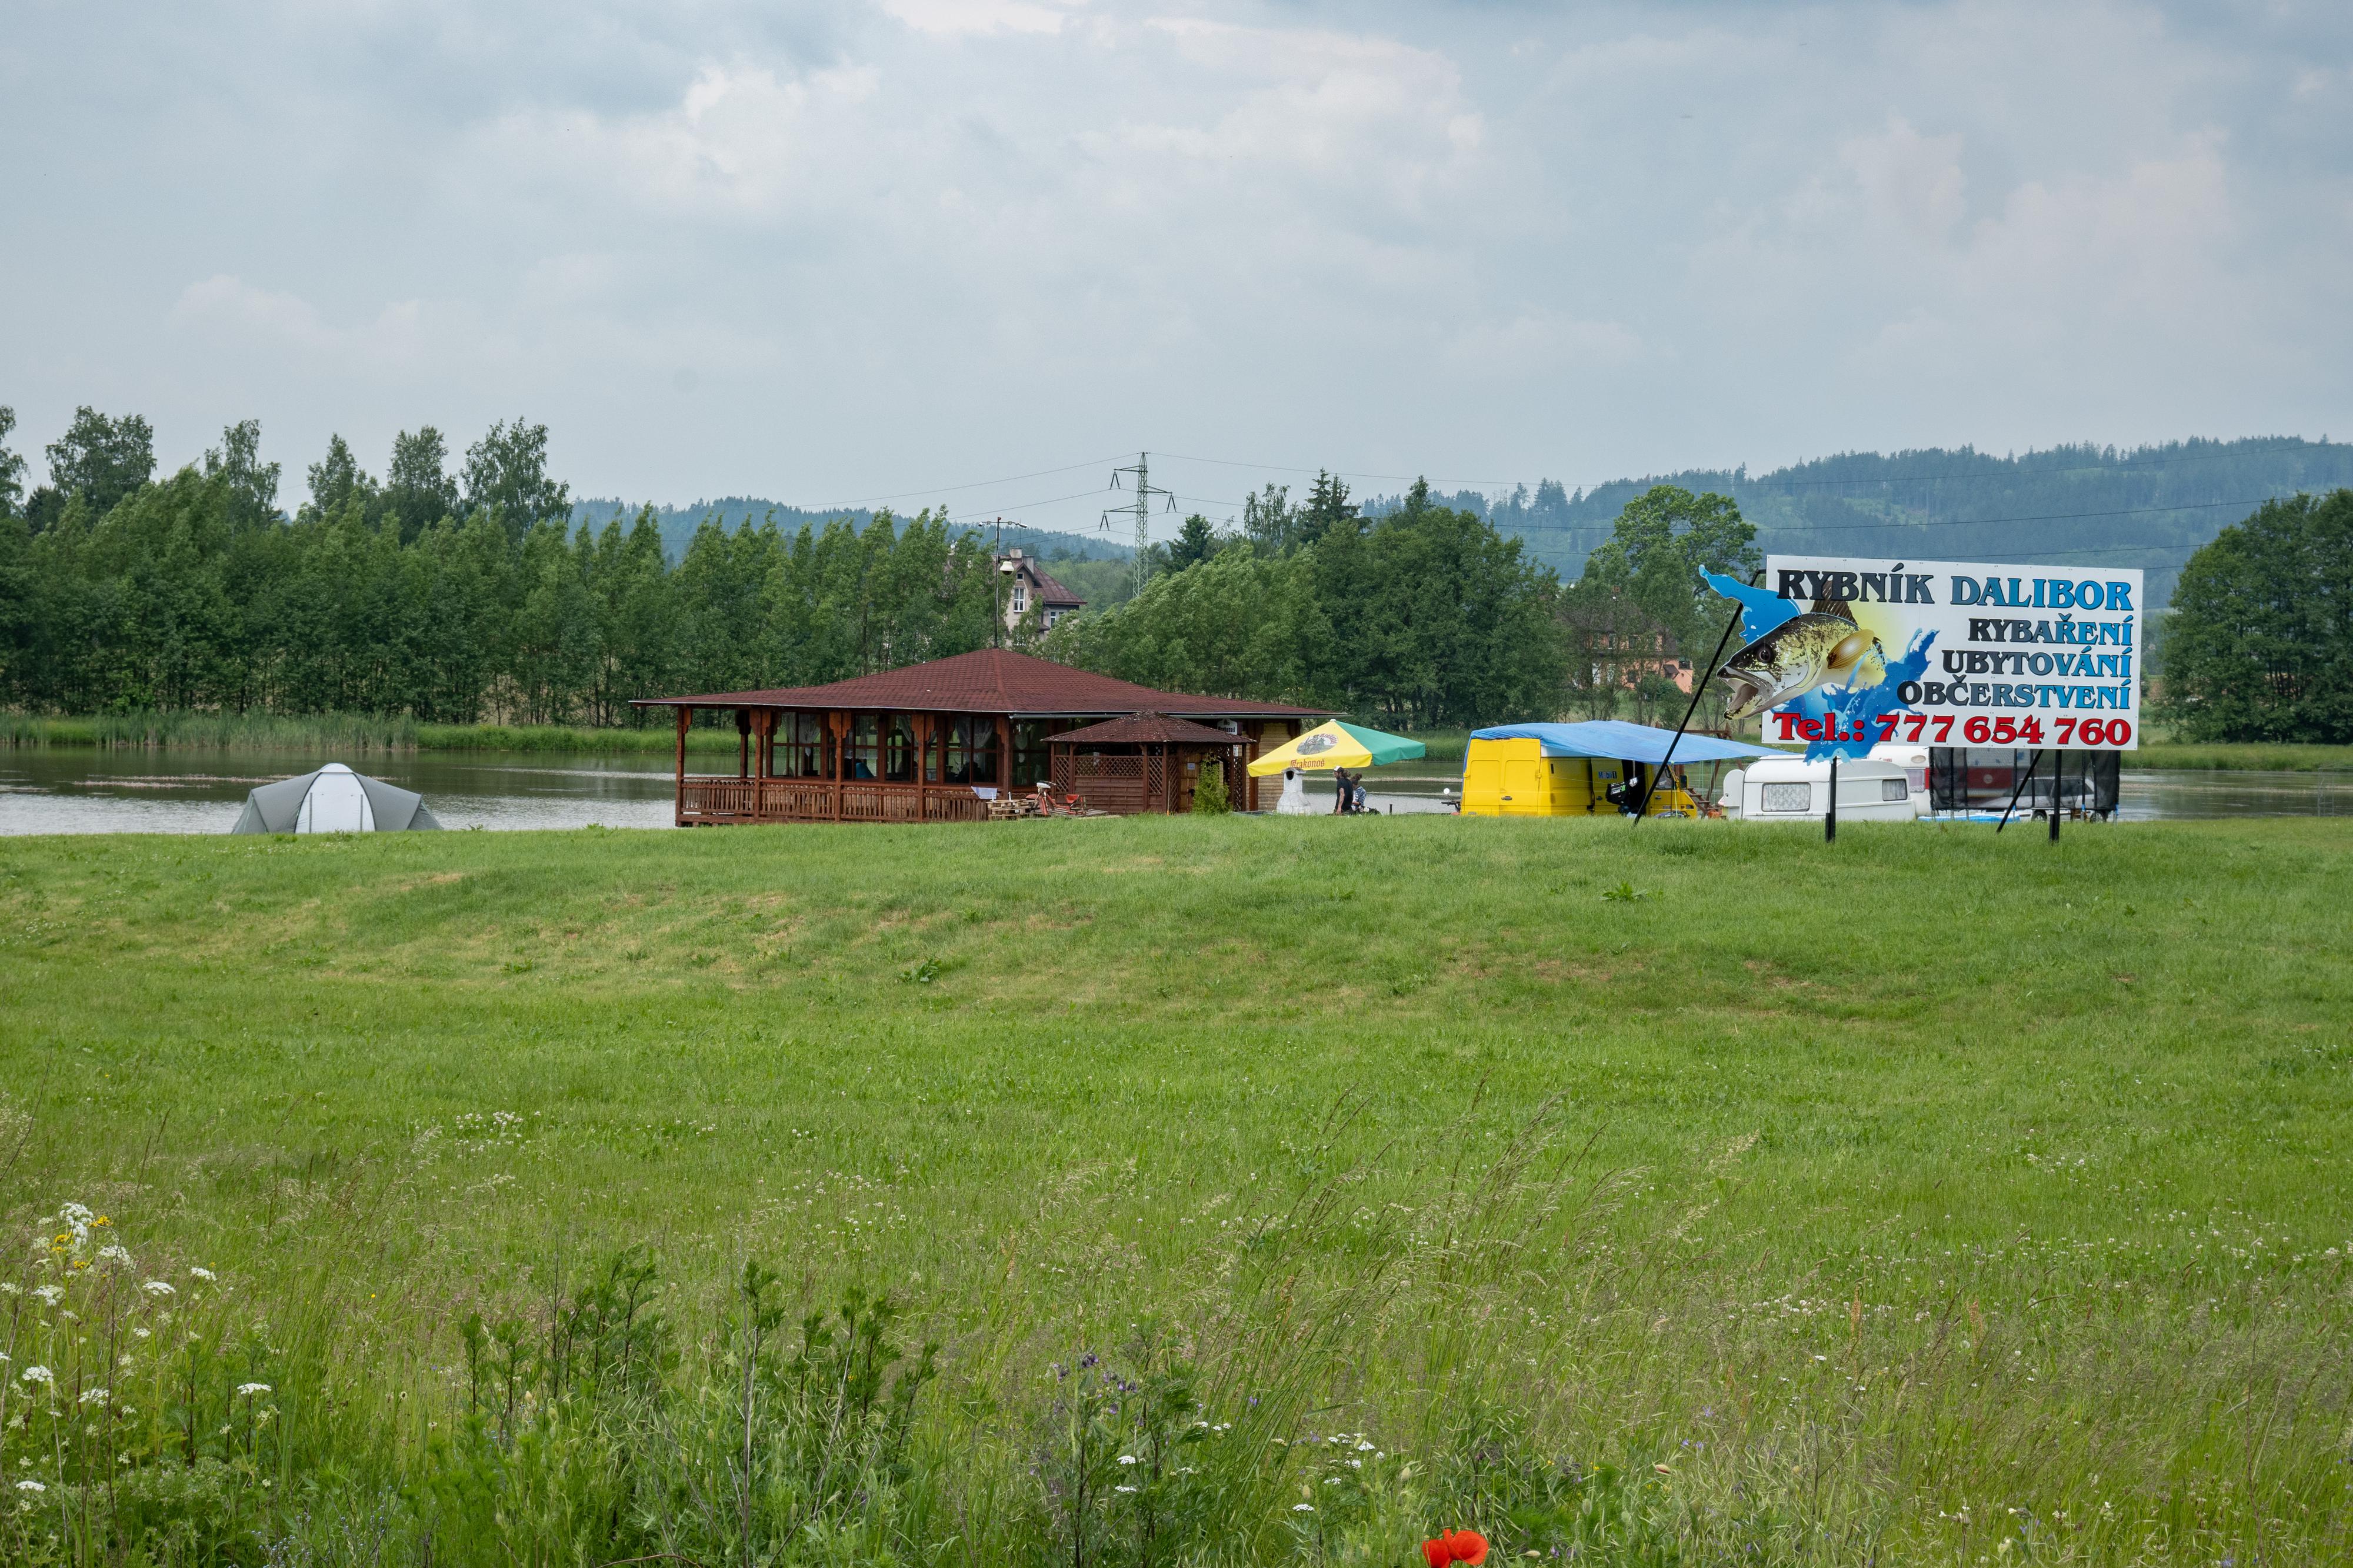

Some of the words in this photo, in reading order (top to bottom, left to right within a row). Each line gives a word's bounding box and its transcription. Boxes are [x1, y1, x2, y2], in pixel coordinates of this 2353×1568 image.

[1777, 562, 1935, 604] RYBNÍK
[1950, 576, 2134, 610] DALIBOR
[1968, 613, 2134, 646] RYBAŘENÍ
[1941, 646, 2133, 678] UBYTOVÁNÍ
[1897, 674, 2131, 709] OBČERSTVENÍ
[1772, 712, 1864, 741] Tel.:
[1875, 713, 1955, 743] 777
[1963, 715, 2045, 744] 654
[2054, 717, 2132, 745] 760
